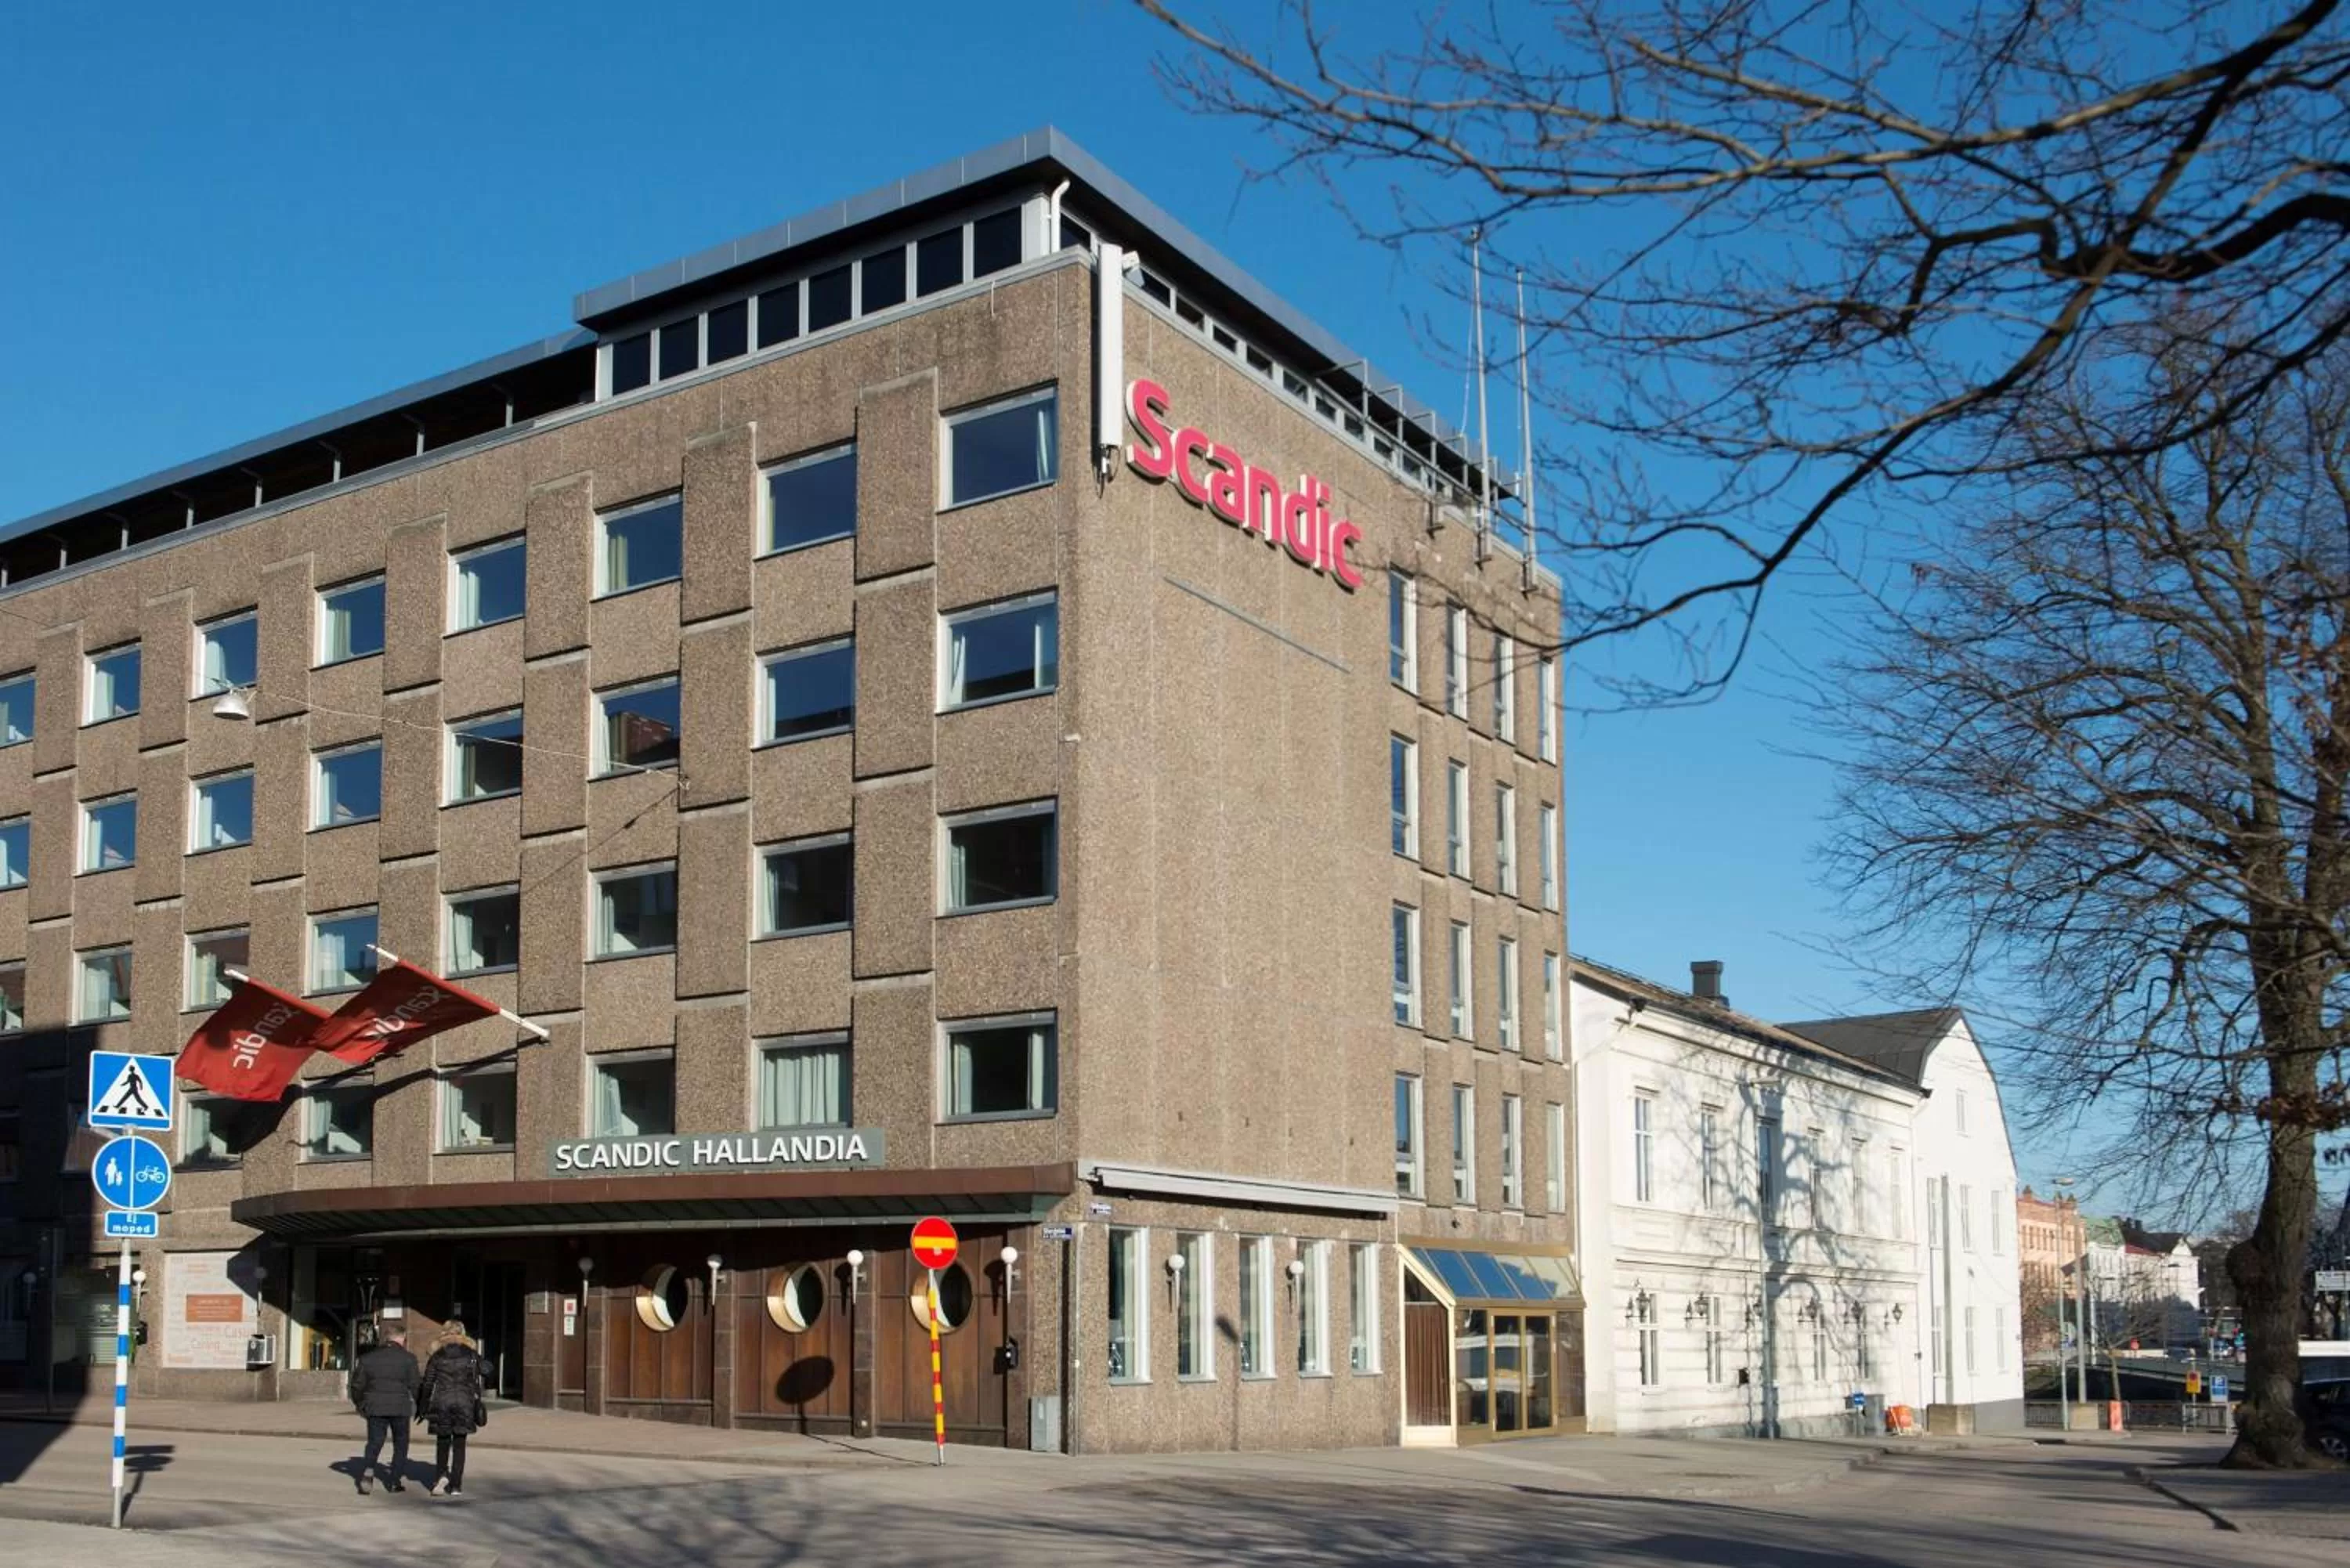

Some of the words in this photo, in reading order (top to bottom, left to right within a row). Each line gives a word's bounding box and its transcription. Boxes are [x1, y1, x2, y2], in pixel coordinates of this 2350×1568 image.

[1126, 378, 1365, 590] Scandic
[555, 1140, 681, 1170] SCANDIC
[692, 1133, 869, 1165] HALLANDIA
[112, 1224, 151, 1234] moped
